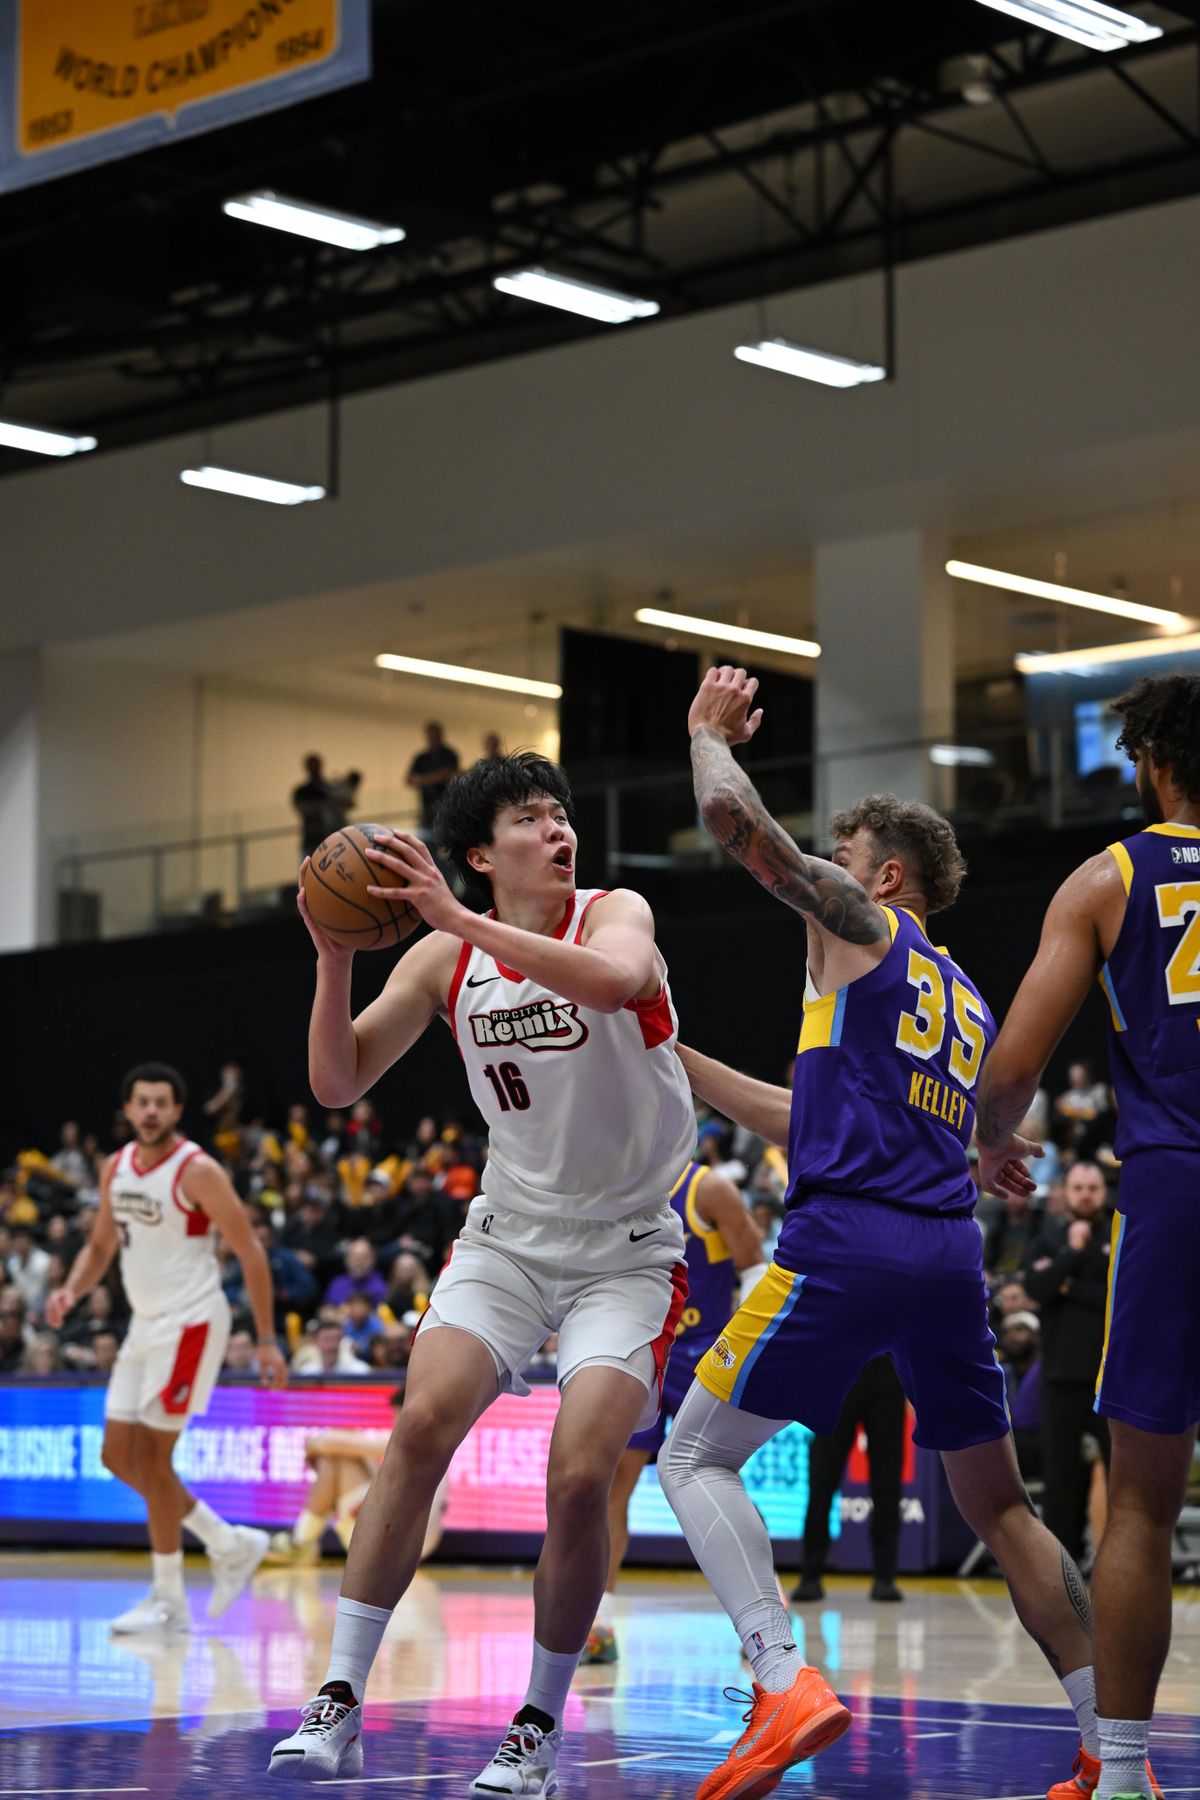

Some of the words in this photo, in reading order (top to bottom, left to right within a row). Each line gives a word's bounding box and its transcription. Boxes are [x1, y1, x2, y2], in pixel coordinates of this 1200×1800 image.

[54, 46, 140, 98] WORLD
[469, 1001, 586, 1051] Remix
[491, 1011, 510, 1021] RIP
[511, 1004, 539, 1019] CITY
[896, 947, 986, 1090] 35
[483, 1062, 531, 1111] 16
[908, 1071, 967, 1130] KELLEY
